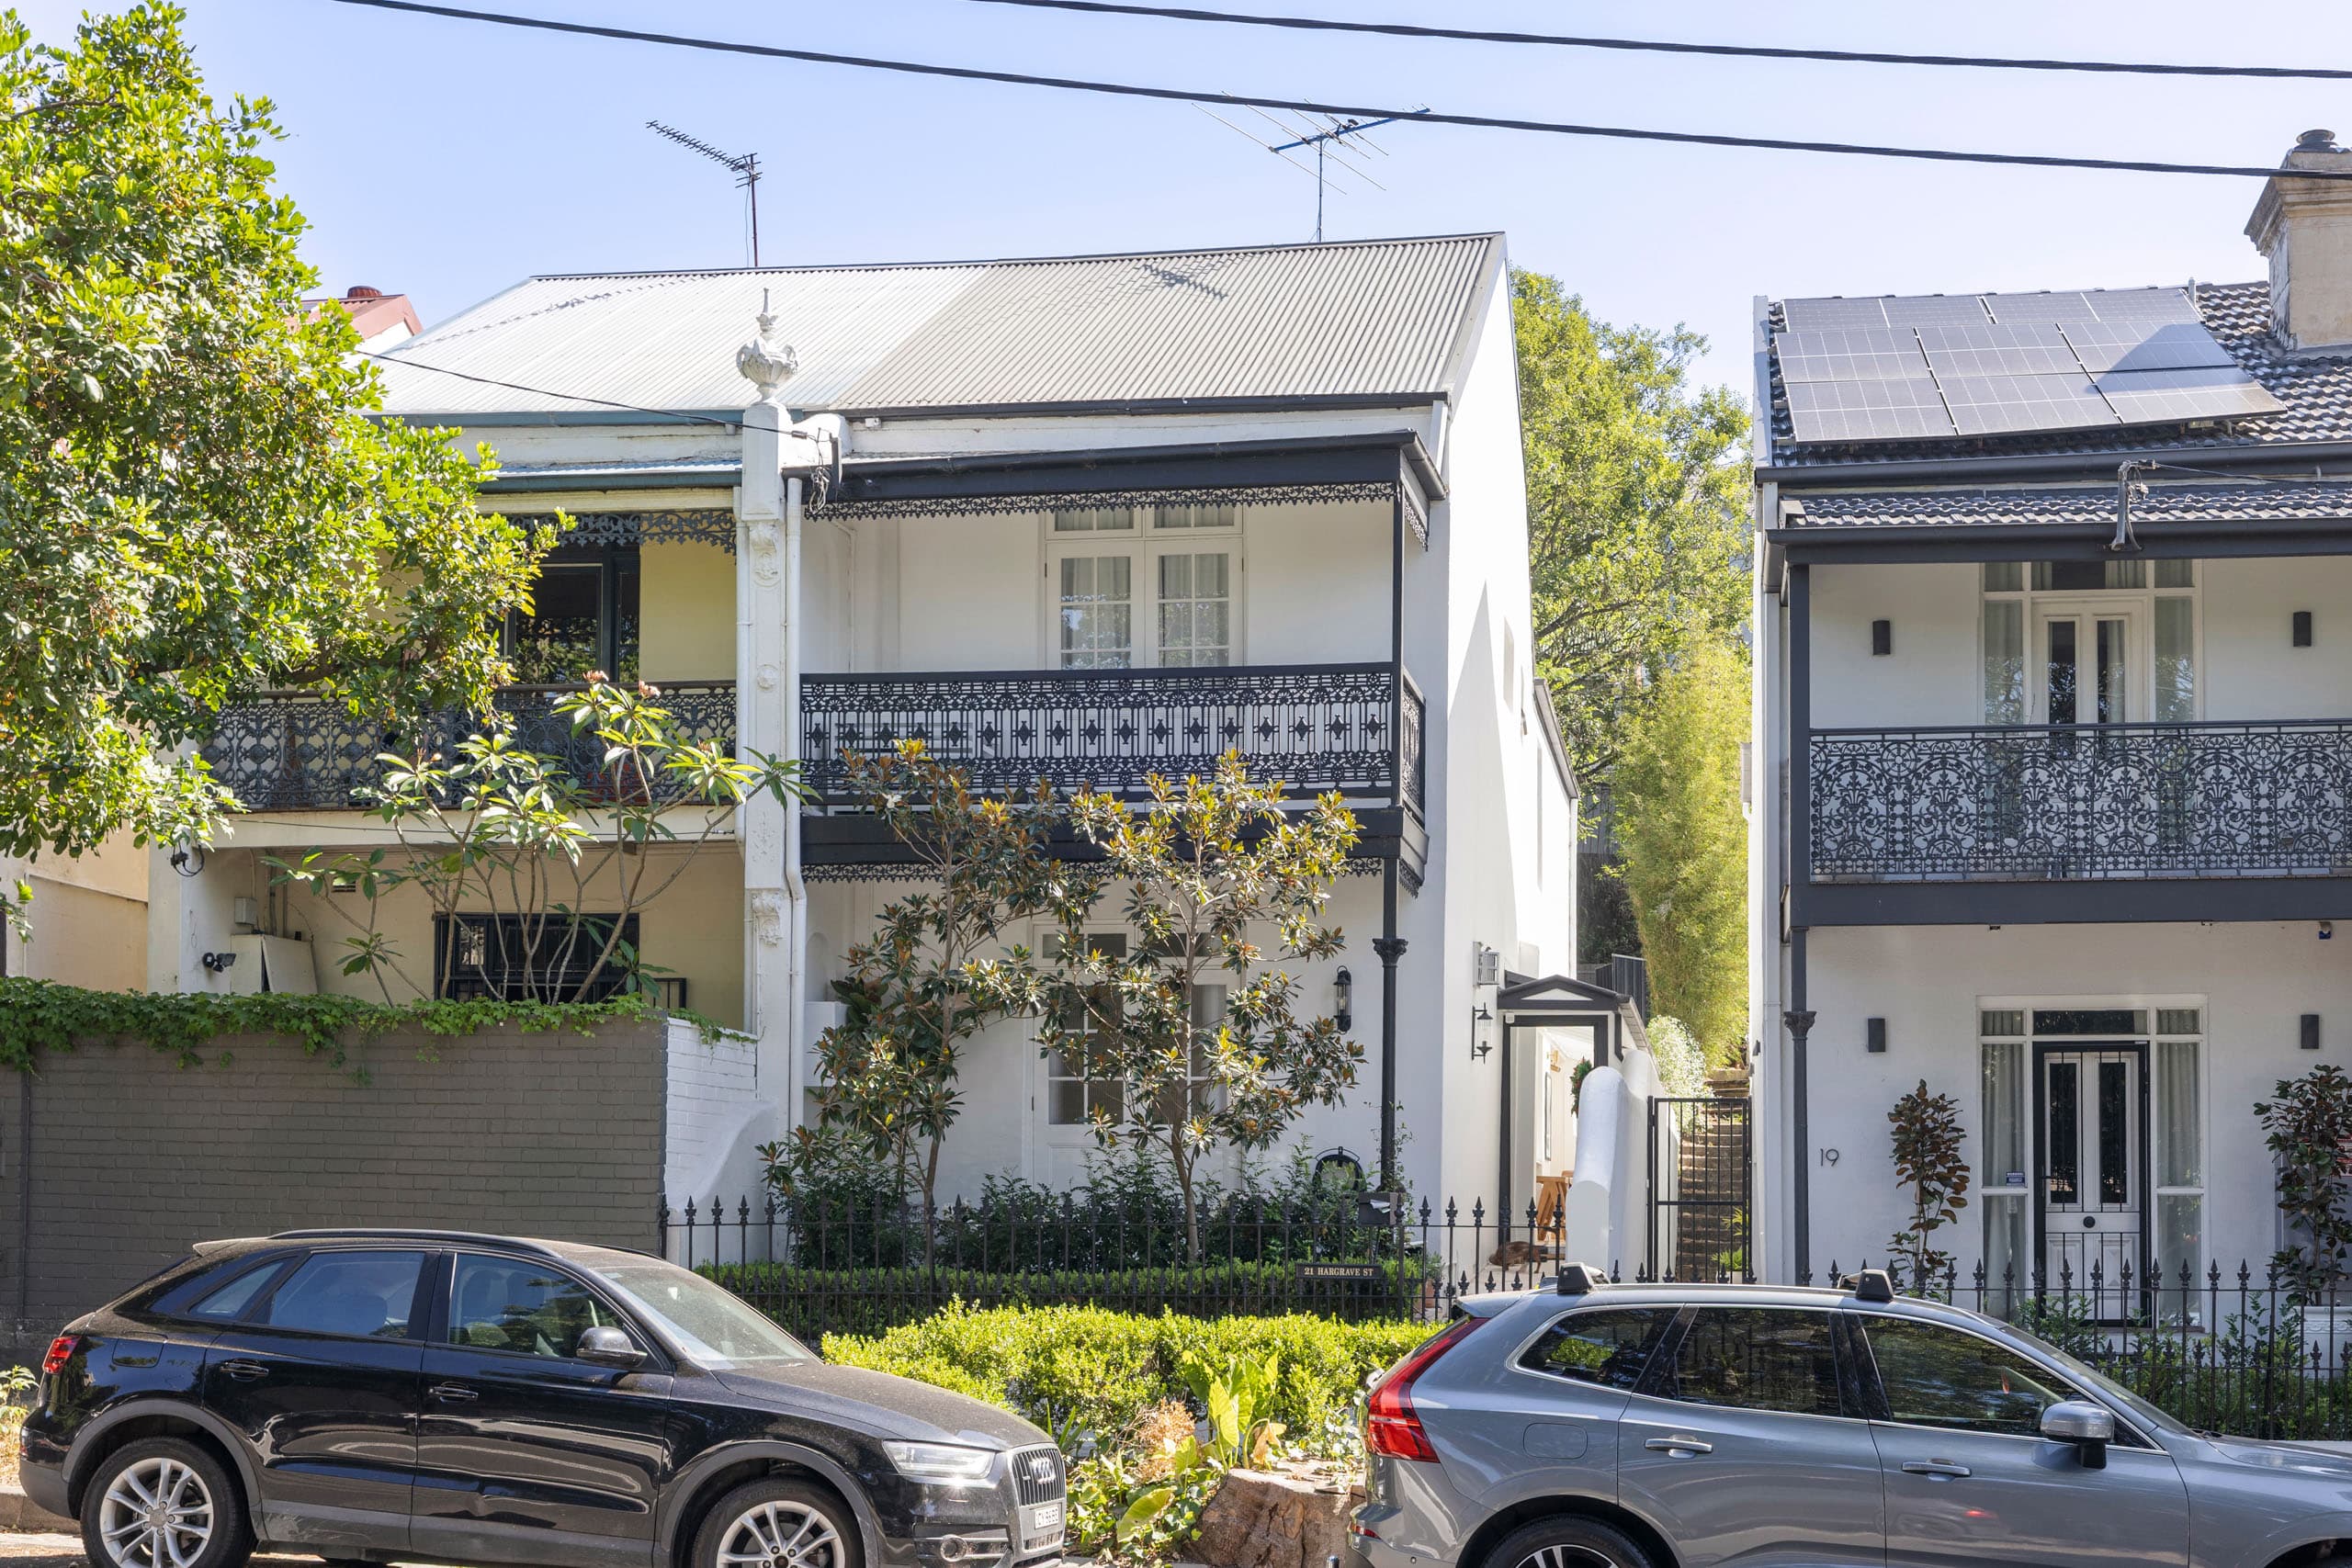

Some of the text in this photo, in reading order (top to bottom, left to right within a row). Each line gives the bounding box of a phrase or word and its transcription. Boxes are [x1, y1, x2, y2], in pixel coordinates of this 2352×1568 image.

[1820, 1148, 1839, 1167] 19
[1304, 1267, 1314, 1275] 21
[1317, 1268, 1361, 1276] HARGRAVE
